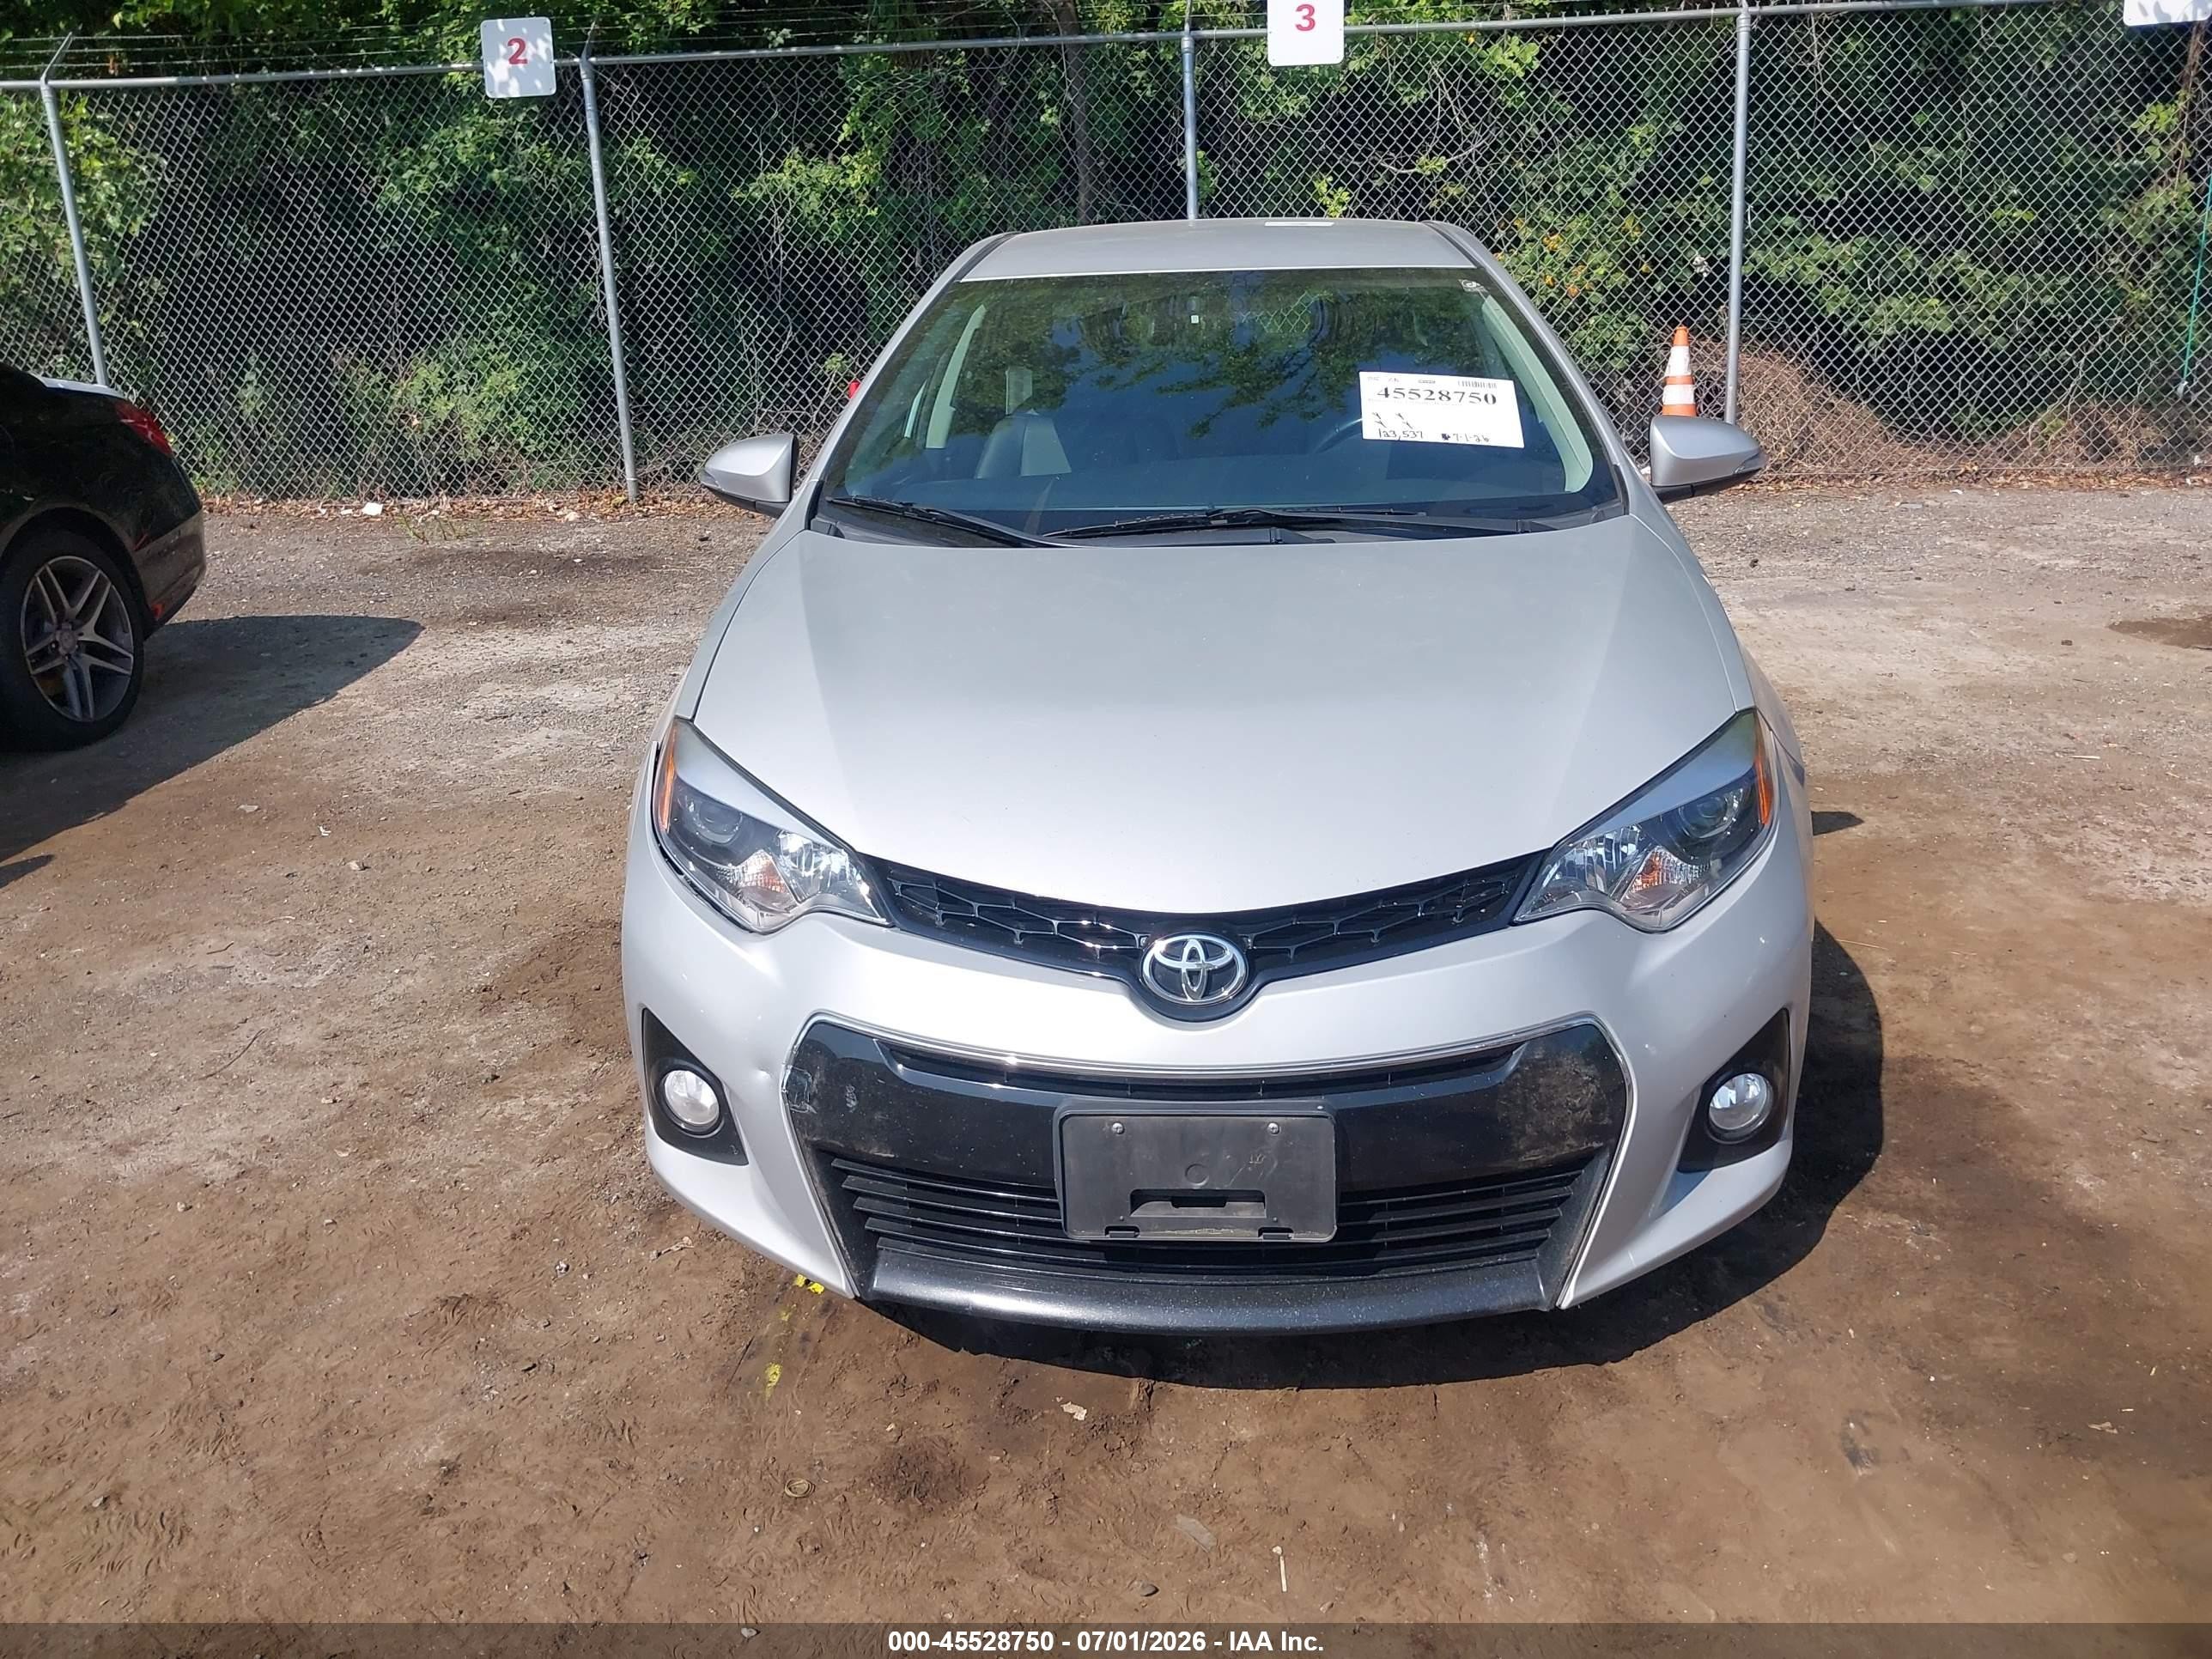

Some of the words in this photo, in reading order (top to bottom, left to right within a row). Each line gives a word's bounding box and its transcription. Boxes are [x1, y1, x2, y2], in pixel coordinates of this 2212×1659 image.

[1295, 4, 1316, 32] 3
[507, 38, 528, 64] 2
[1376, 386, 1497, 405] 45528750
[1377, 428, 1425, 441] 123,537
